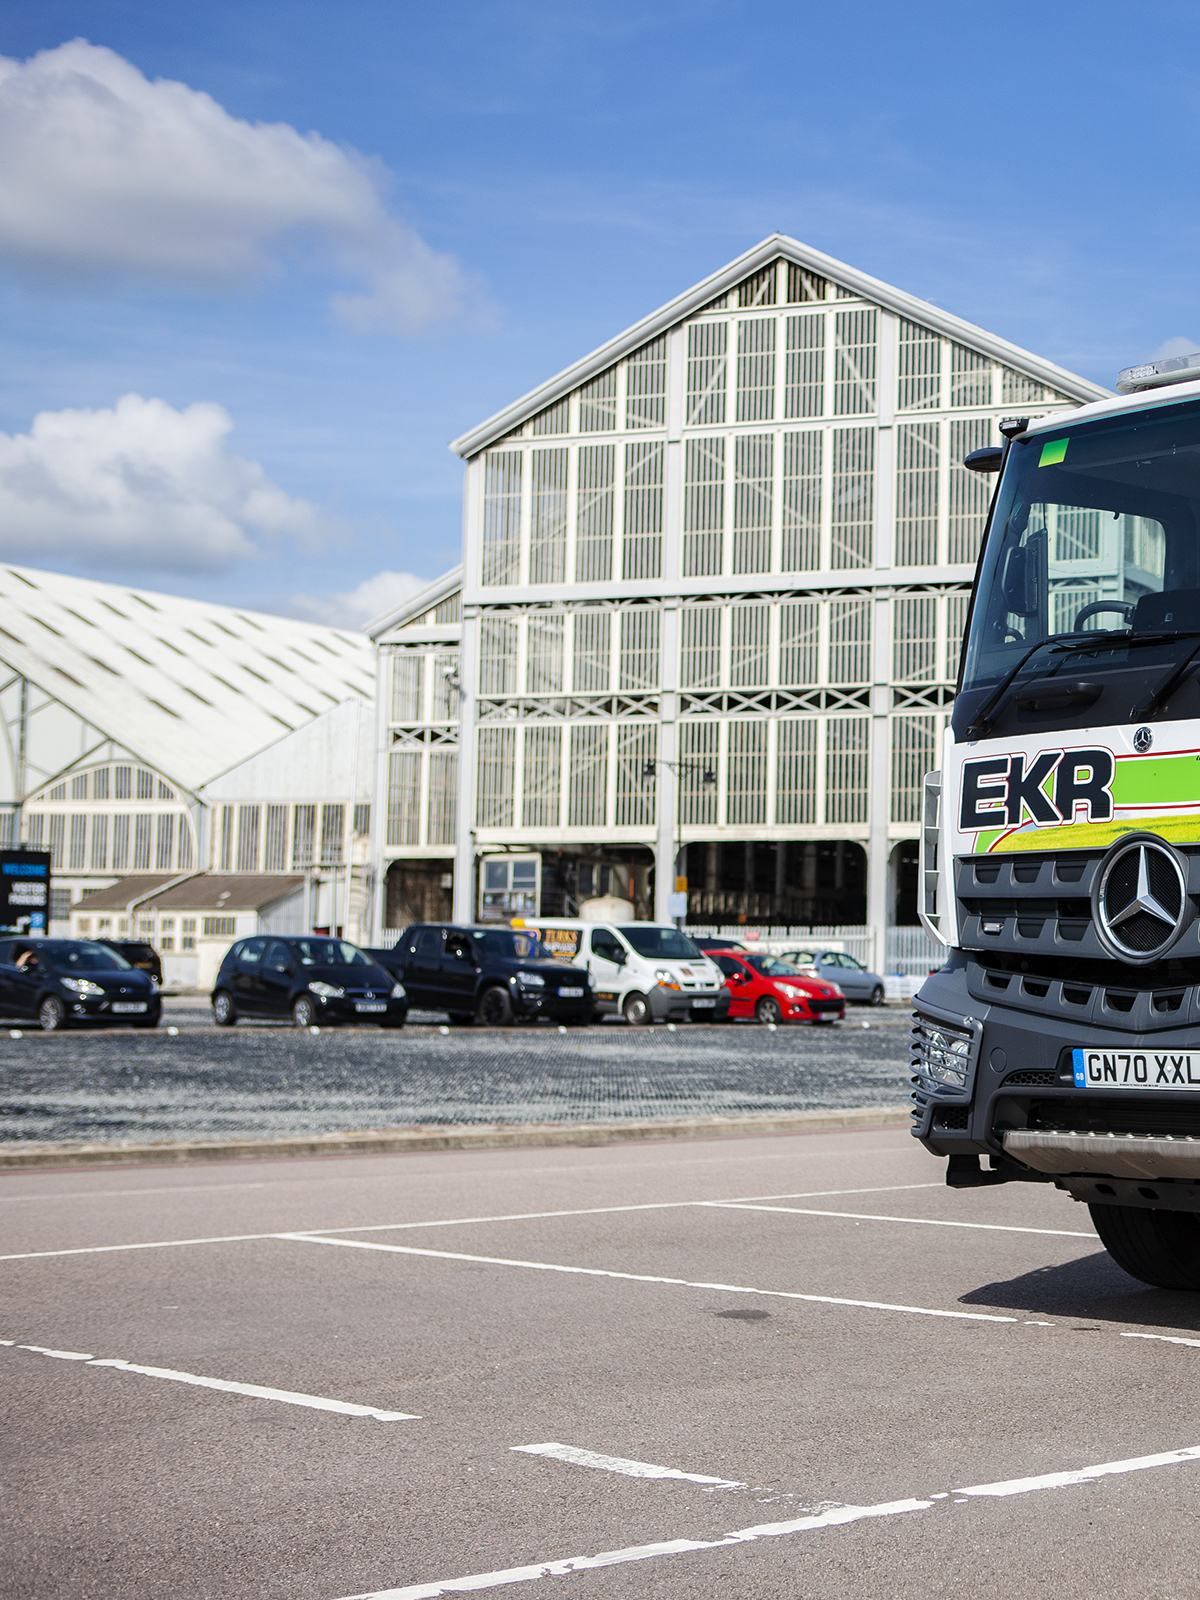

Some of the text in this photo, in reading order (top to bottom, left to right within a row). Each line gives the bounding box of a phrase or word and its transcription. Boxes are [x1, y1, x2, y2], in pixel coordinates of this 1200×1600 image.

[959, 747, 1114, 832] EKR
[2, 863, 47, 877] WELCOME
[1075, 1072, 1085, 1081] GB
[1088, 1053, 1148, 1083] GN70
